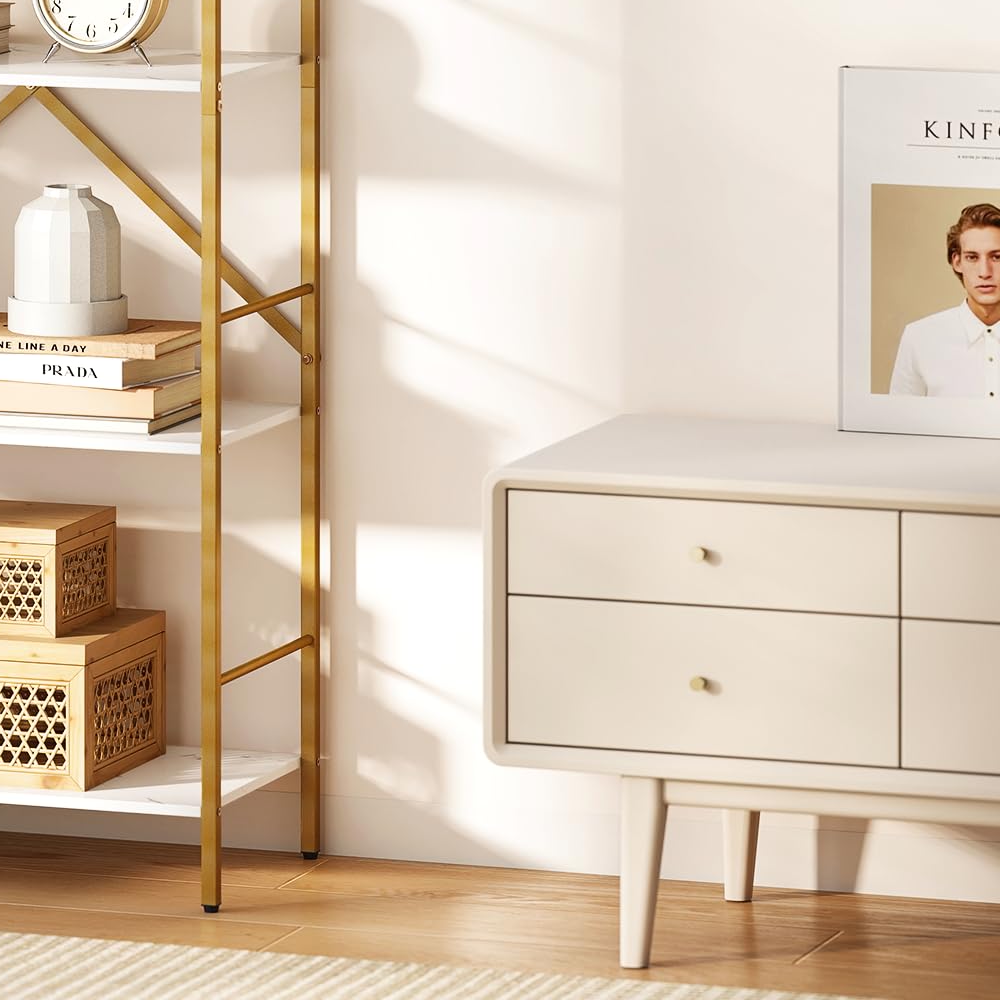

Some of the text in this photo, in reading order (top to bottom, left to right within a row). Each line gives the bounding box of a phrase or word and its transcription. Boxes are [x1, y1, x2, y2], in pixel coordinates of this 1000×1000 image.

[51, 0, 62, 14] 8
[122, 2, 134, 19] 4
[67, 15, 77, 32] 7
[86, 24, 96, 38] 6
[108, 17, 119, 33] 5
[924, 120, 1000, 141] KINF
[18, 342, 45, 352] LINE
[51, 343, 59, 352] A
[62, 344, 88, 353] DAY
[42, 363, 98, 379] PRADA
